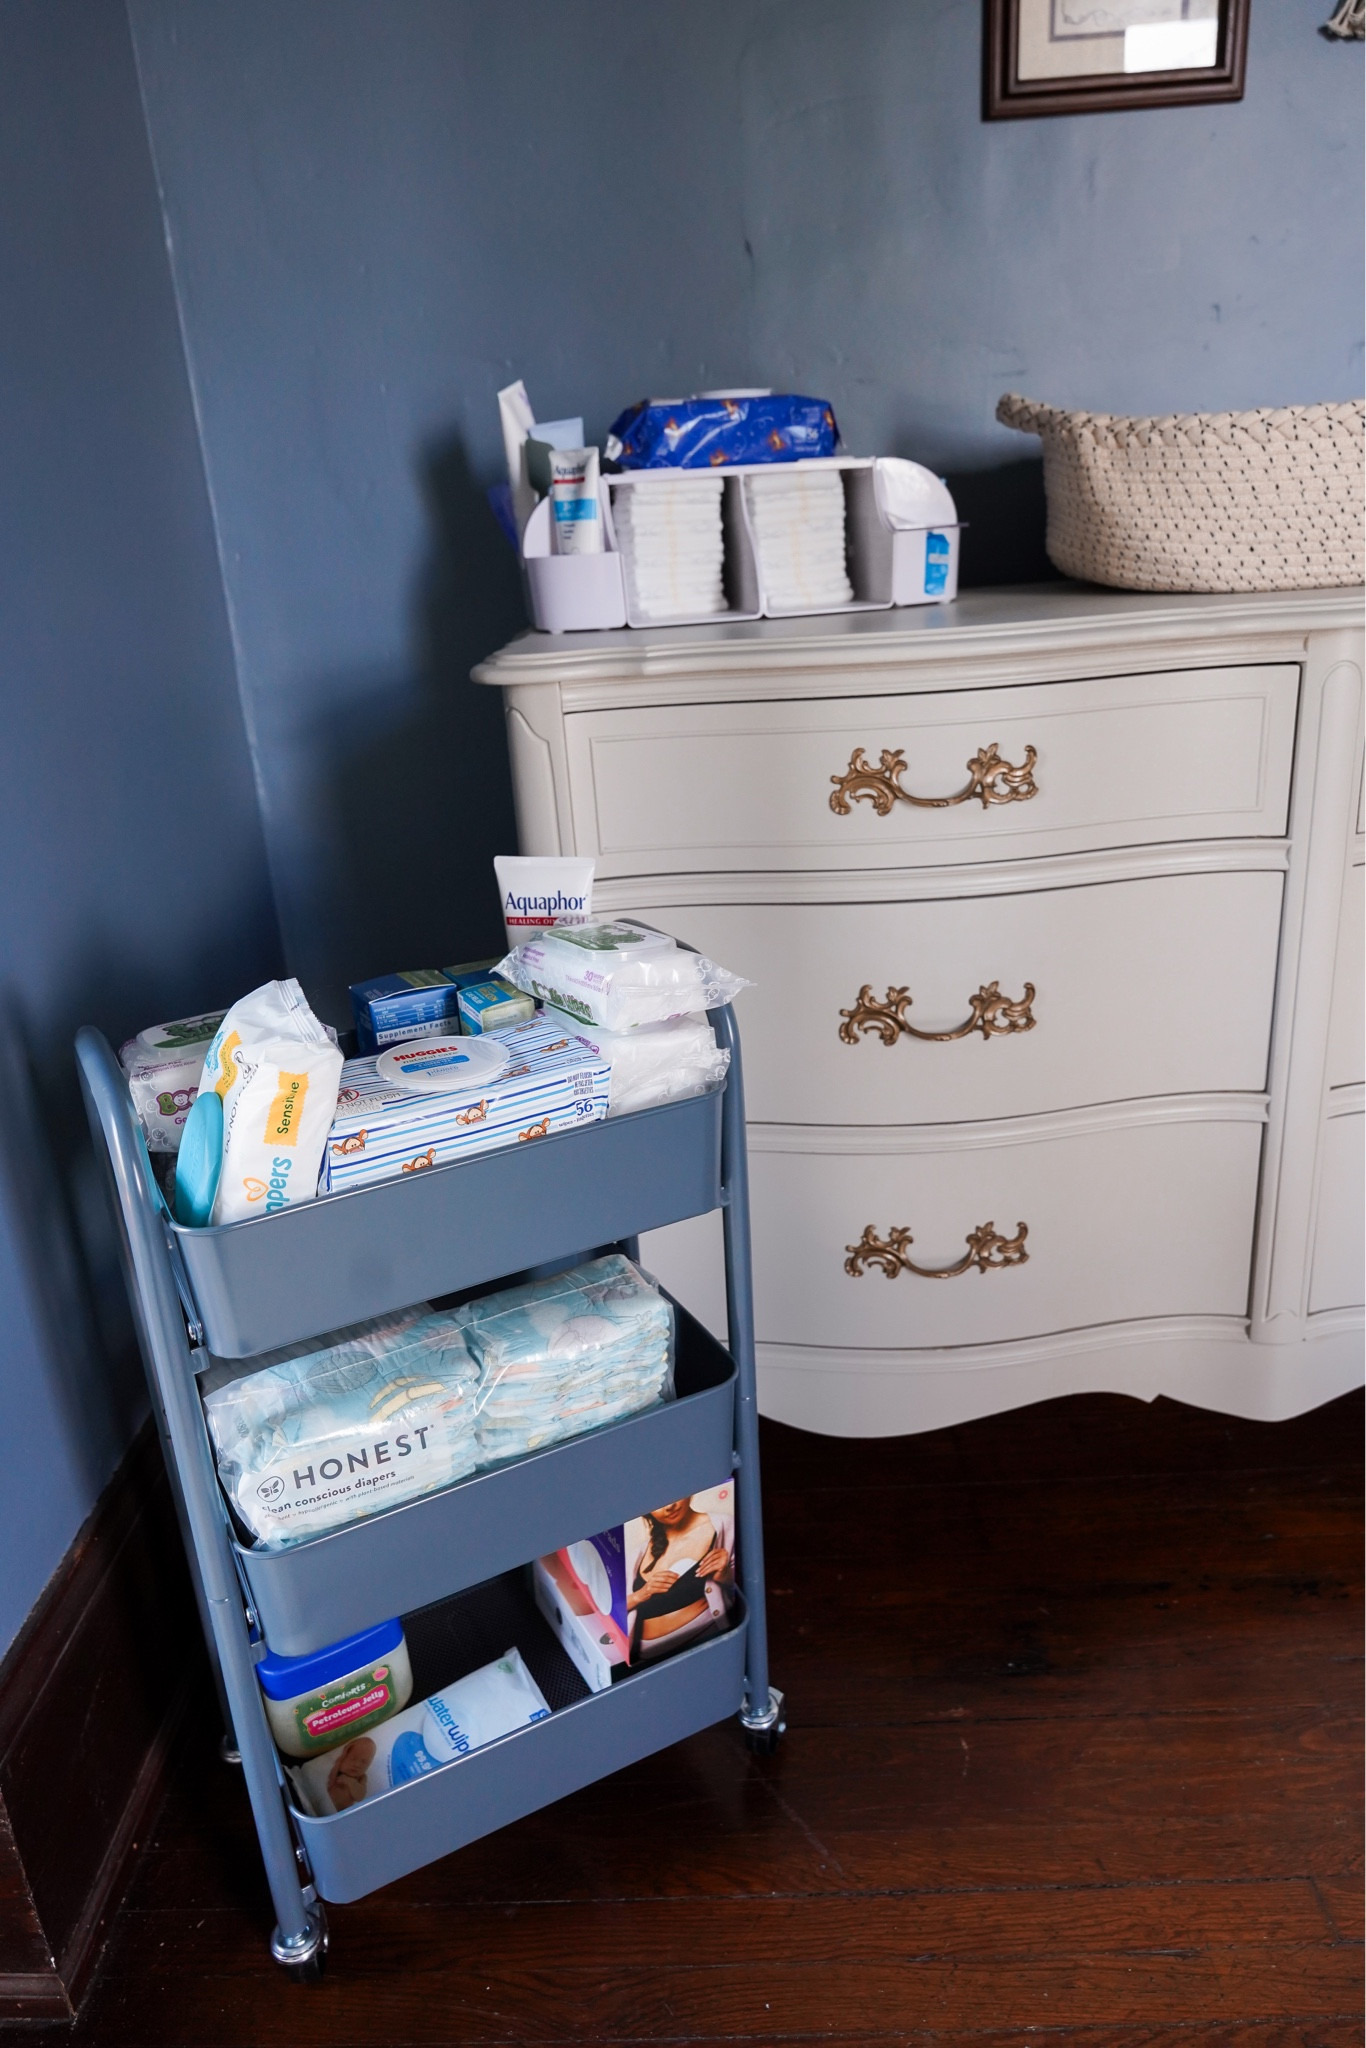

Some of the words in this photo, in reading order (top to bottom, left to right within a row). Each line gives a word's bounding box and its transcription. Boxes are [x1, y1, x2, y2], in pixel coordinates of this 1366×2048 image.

[505, 890, 587, 916] Aquaphor
[583, 970, 594, 982] 30
[378, 1025, 427, 1040] Supplement
[429, 1020, 452, 1030] Facts
[392, 1045, 458, 1062] HUGGIES
[402, 1054, 436, 1064] natural
[276, 1081, 300, 1135] Sensitve
[345, 1099, 367, 1109] NOT
[369, 1092, 401, 1102] FLUSH
[576, 1100, 593, 1116] 56
[229, 1101, 239, 1126] NOT
[293, 1426, 430, 1490] HONEST
[295, 1484, 352, 1508] conscious
[354, 1470, 397, 1490] diapers
[357, 1482, 390, 1499] plant-based
[311, 1701, 361, 1727] Petroleum
[361, 1689, 385, 1705] Jelly
[414, 1750, 433, 1771] 99.9
